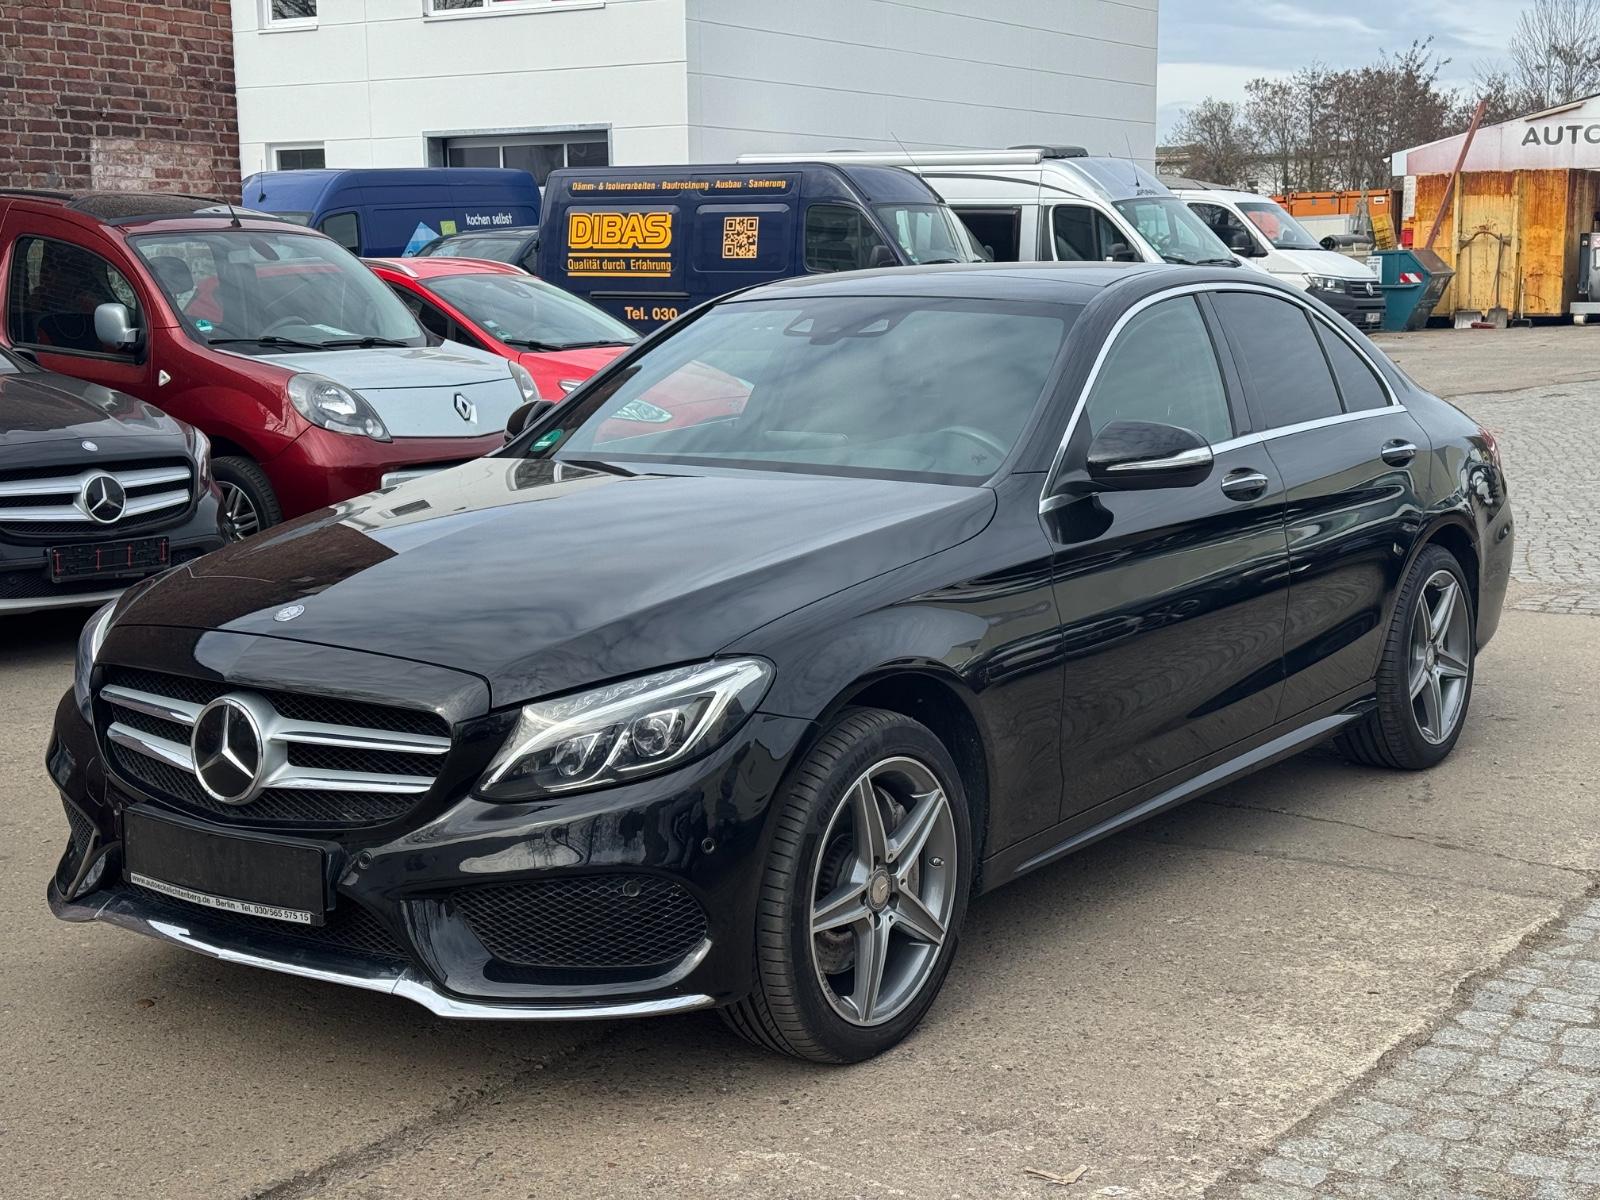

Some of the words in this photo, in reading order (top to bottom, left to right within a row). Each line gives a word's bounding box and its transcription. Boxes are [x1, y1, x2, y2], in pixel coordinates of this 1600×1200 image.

[572, 182, 596, 191] Dämm-
[598, 182, 604, 191] &
[605, 181, 656, 190] Isolierarbeiten
[661, 180, 709, 190] Bautrocknung
[715, 180, 742, 189] Ausbau
[748, 179, 786, 189] Sanierung
[465, 213, 491, 226] kochen
[492, 212, 512, 225] selbst
[567, 212, 672, 249] DIBAS
[567, 259, 600, 270] Qualität
[602, 259, 626, 270] durch
[630, 259, 671, 272] Erfahrung
[624, 307, 648, 320] Tel.
[215, 899, 236, 910] Berlin
[241, 904, 253, 912] Tel.
[254, 906, 282, 917] 030/565
[284, 910, 298, 920] 575
[300, 913, 309, 921] 15
